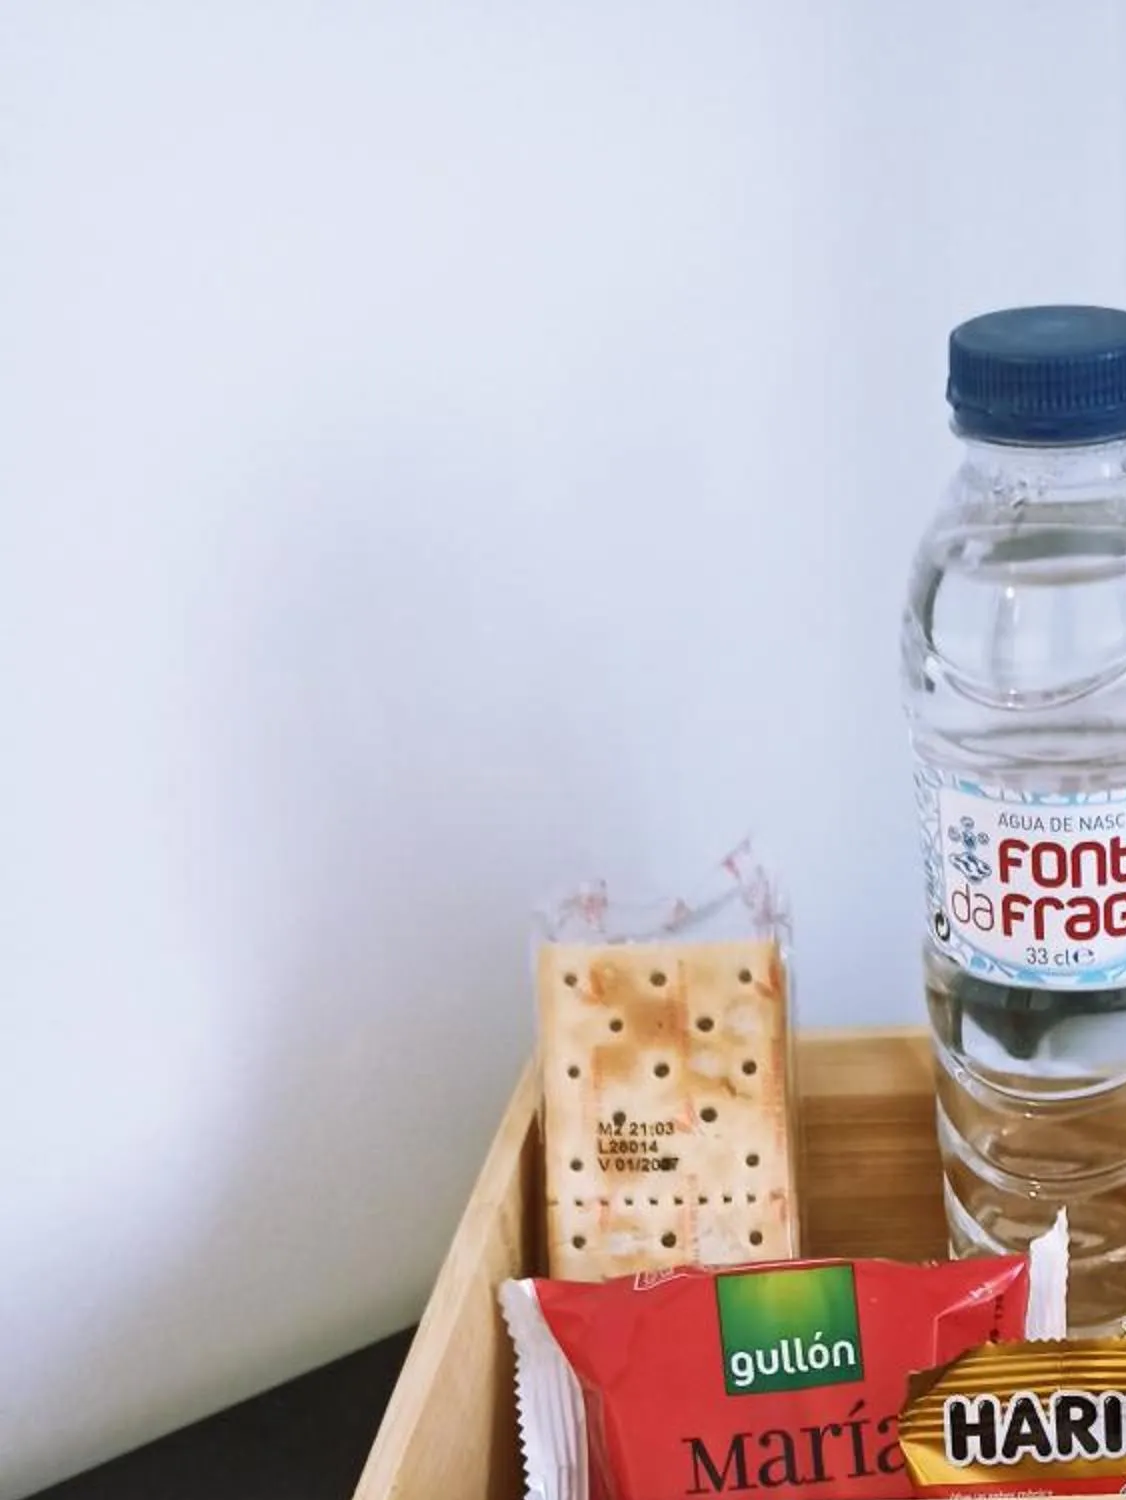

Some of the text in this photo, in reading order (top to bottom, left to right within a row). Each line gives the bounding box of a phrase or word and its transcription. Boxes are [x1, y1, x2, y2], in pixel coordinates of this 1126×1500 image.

[1051, 817, 1073, 832] DE
[951, 884, 995, 932] da
[1026, 948, 1071, 966] 33 cl
[630, 1122, 675, 1136] 21:03
[598, 1157, 679, 1172] V 01/207
[730, 1333, 856, 1386] gullón
